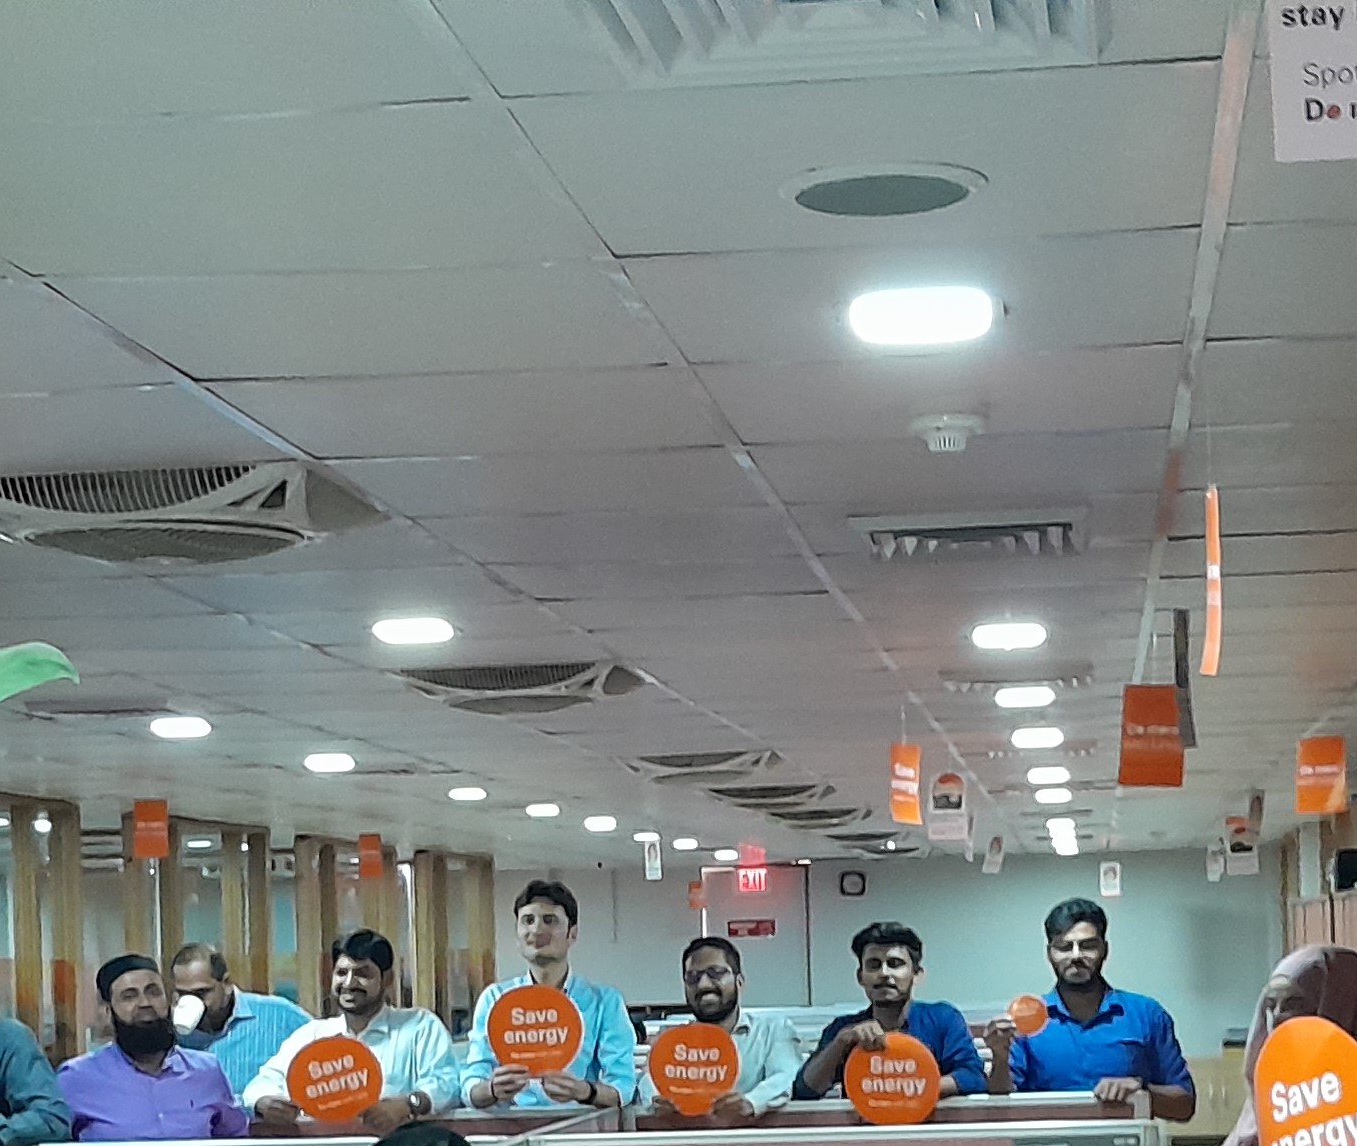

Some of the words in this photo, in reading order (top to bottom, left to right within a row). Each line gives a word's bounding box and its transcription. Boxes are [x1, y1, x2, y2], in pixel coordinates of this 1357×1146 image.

[1282, 4, 1344, 30] stay
[1305, 98, 1341, 122] Do
[739, 868, 767, 891] EXIT
[511, 1007, 558, 1026] Save
[504, 1026, 568, 1047] energy
[674, 1043, 720, 1062] Save
[308, 1054, 355, 1079] Save
[664, 1064, 728, 1083] energy
[870, 1055, 916, 1075] Save
[305, 1067, 368, 1098] energy
[861, 1077, 927, 1098] energy
[1271, 1071, 1341, 1123] Save
